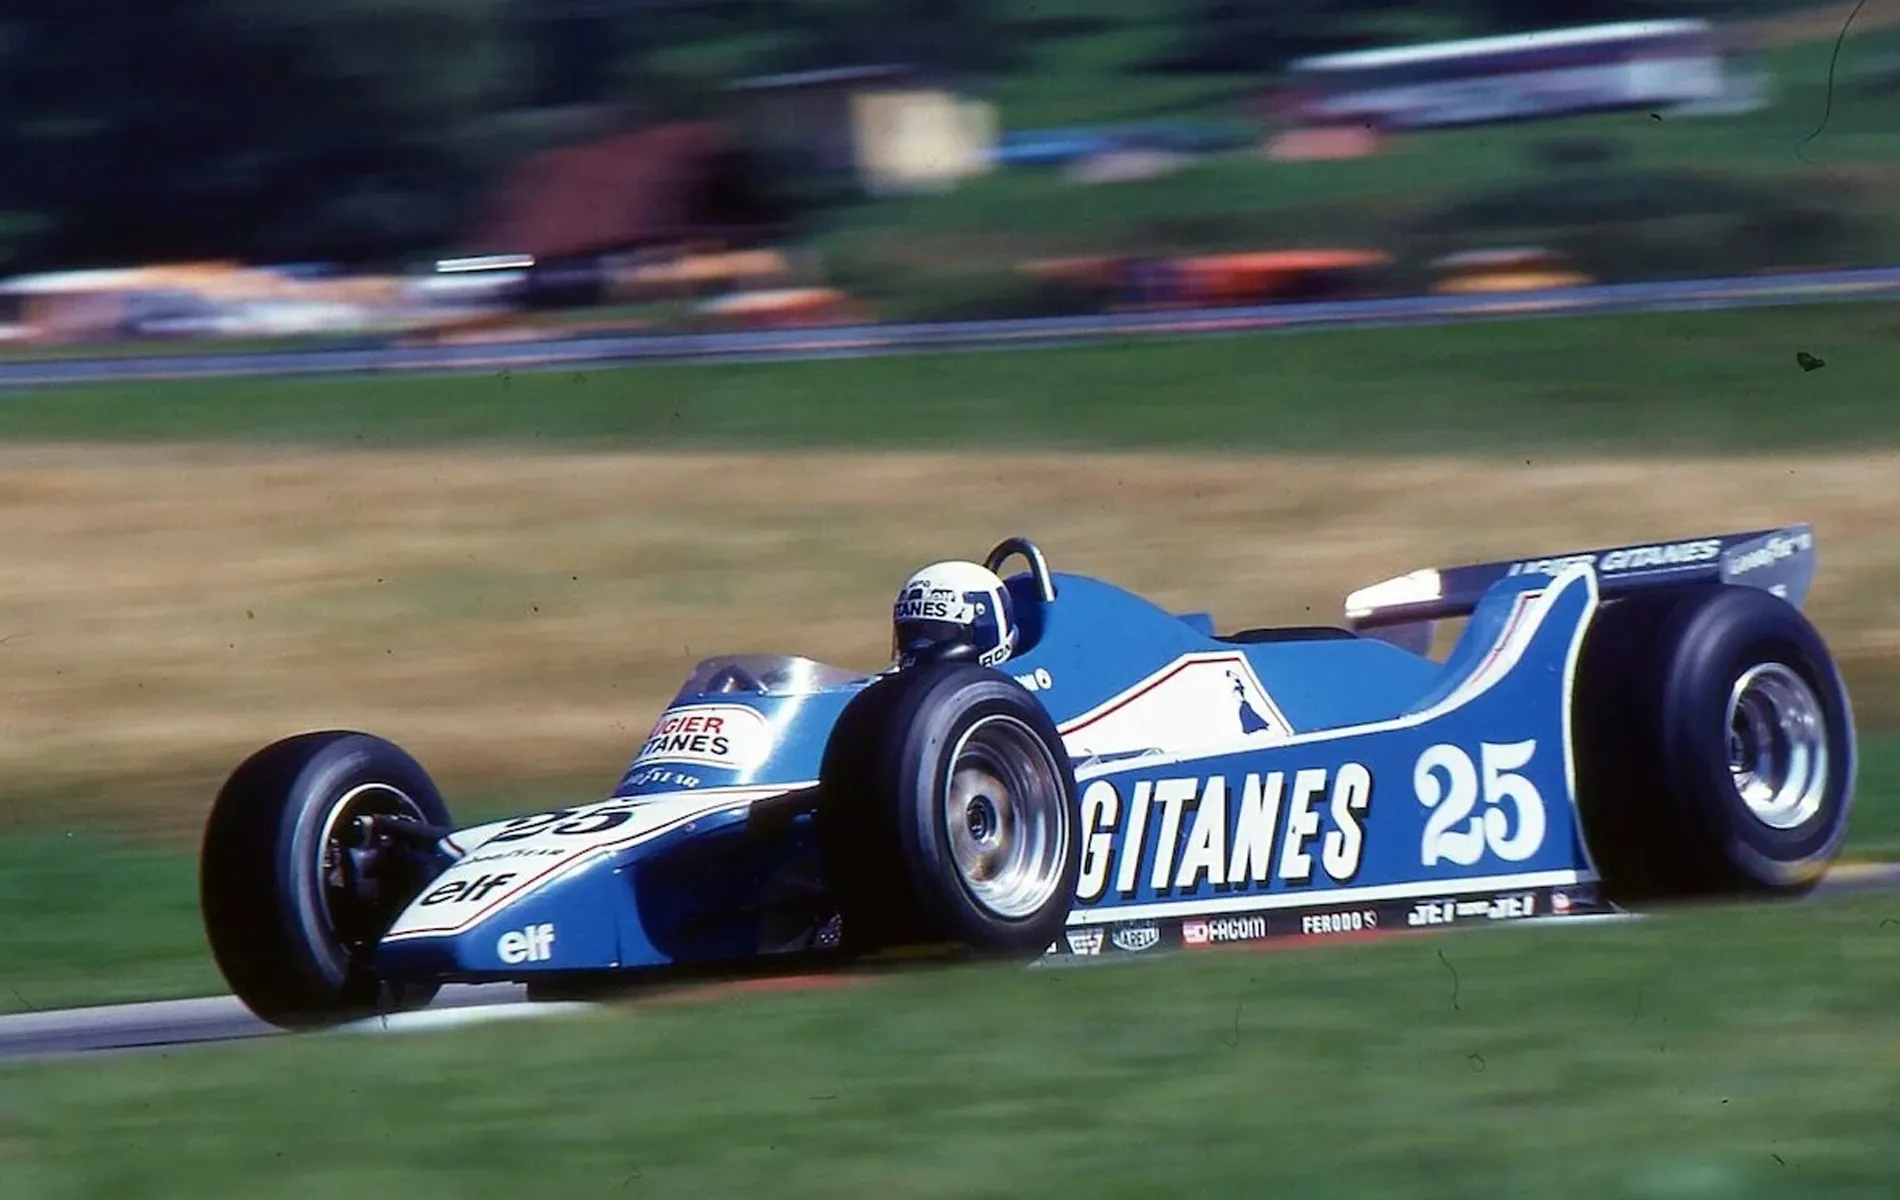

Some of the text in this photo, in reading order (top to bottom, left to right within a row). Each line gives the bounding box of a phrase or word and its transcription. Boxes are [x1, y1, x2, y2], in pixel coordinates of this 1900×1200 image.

[1413, 738, 1546, 866] 25
[475, 800, 652, 850] 25
[1075, 761, 1372, 900] GITANES
[420, 873, 517, 906] elf
[497, 923, 556, 964] elf
[1208, 916, 1266, 942] FACOM
[1302, 911, 1362, 935] FERODO
